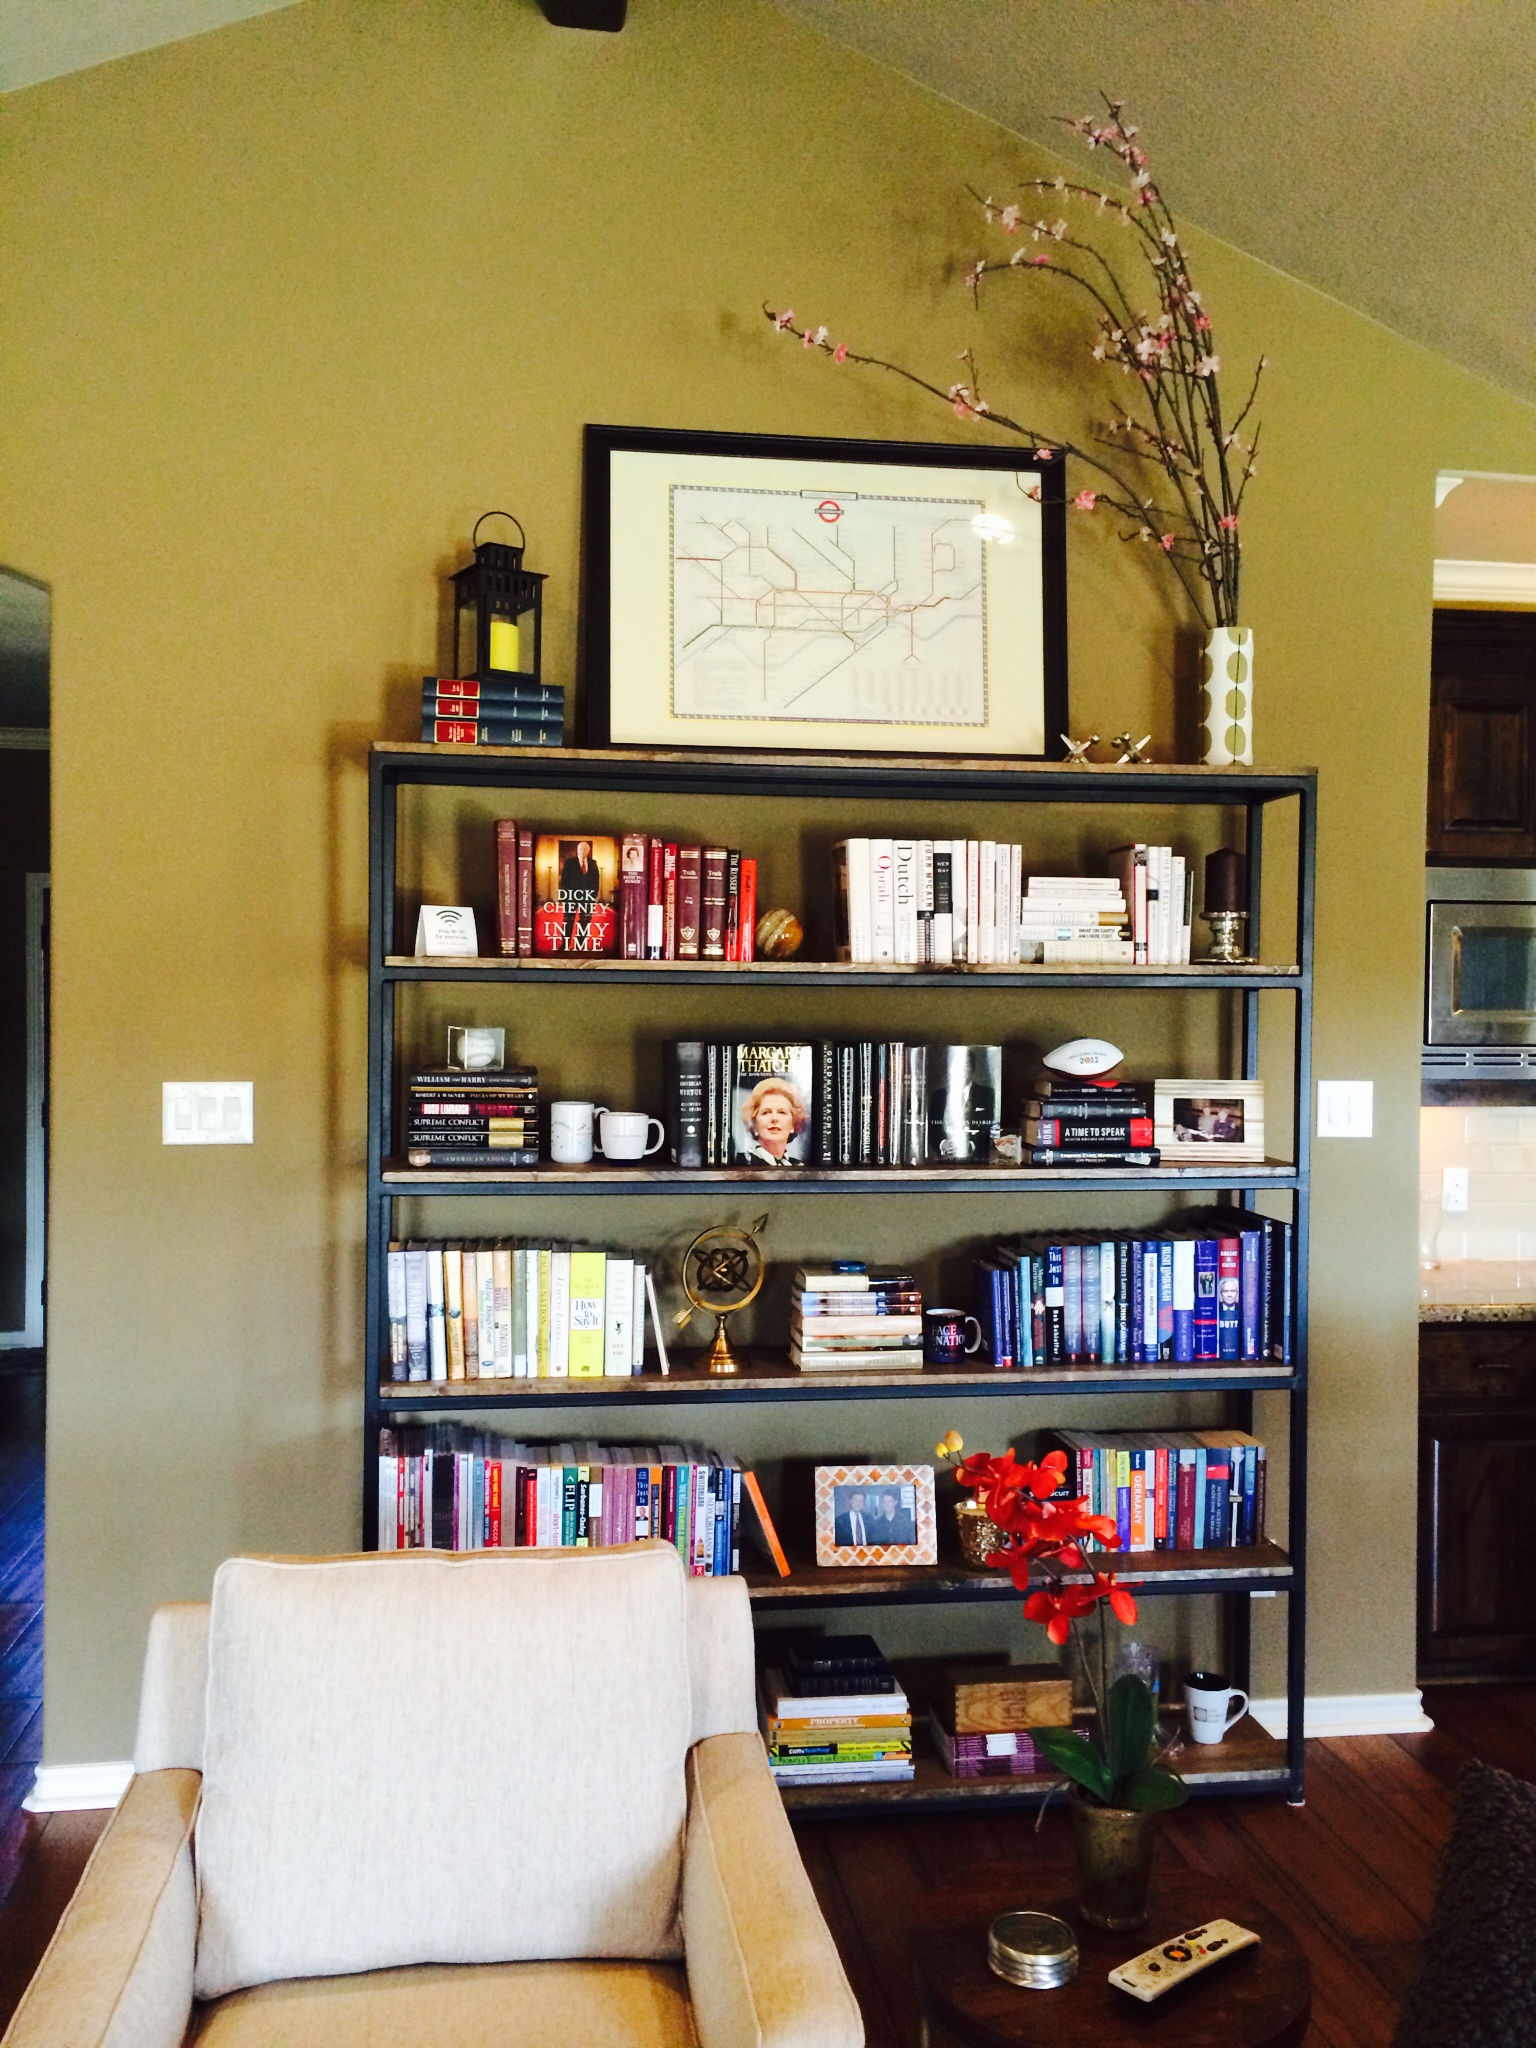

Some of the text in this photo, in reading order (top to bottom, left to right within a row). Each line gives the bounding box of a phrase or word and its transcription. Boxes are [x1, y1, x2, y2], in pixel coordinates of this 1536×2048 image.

[925, 844, 933, 867] JOHN
[729, 854, 739, 895] TIM RUSSERT
[897, 846, 914, 905] Dutch
[558, 889, 596, 901] DICK
[543, 901, 609, 914] CHENEY
[544, 921, 609, 937] IN MY
[547, 937, 603, 952] TIME
[1042, 1123, 1052, 1145] BORK
[1065, 1127, 1125, 1136] A TIME TO SPEAK
[1049, 1251, 1061, 1262] This
[1049, 1264, 1061, 1273] Just
[1160, 1246, 1171, 1301] RUSH LIMBAUGH
[575, 1300, 597, 1311] How
[584, 1310, 593, 1318] to
[574, 1316, 599, 1328] Say It
[1219, 1320, 1238, 1328] DUTY
[932, 1324, 956, 1335] FACE
[936, 1335, 965, 1346] NATIO
[565, 1484, 576, 1511] FLIP
[1134, 1475, 1142, 1524] GERMANY
[578, 1483, 586, 1536] Sarbanes-Oxley
[810, 1717, 859, 1725] PROPERTY
[788, 1747, 831, 1755] CliffsTestPrep
